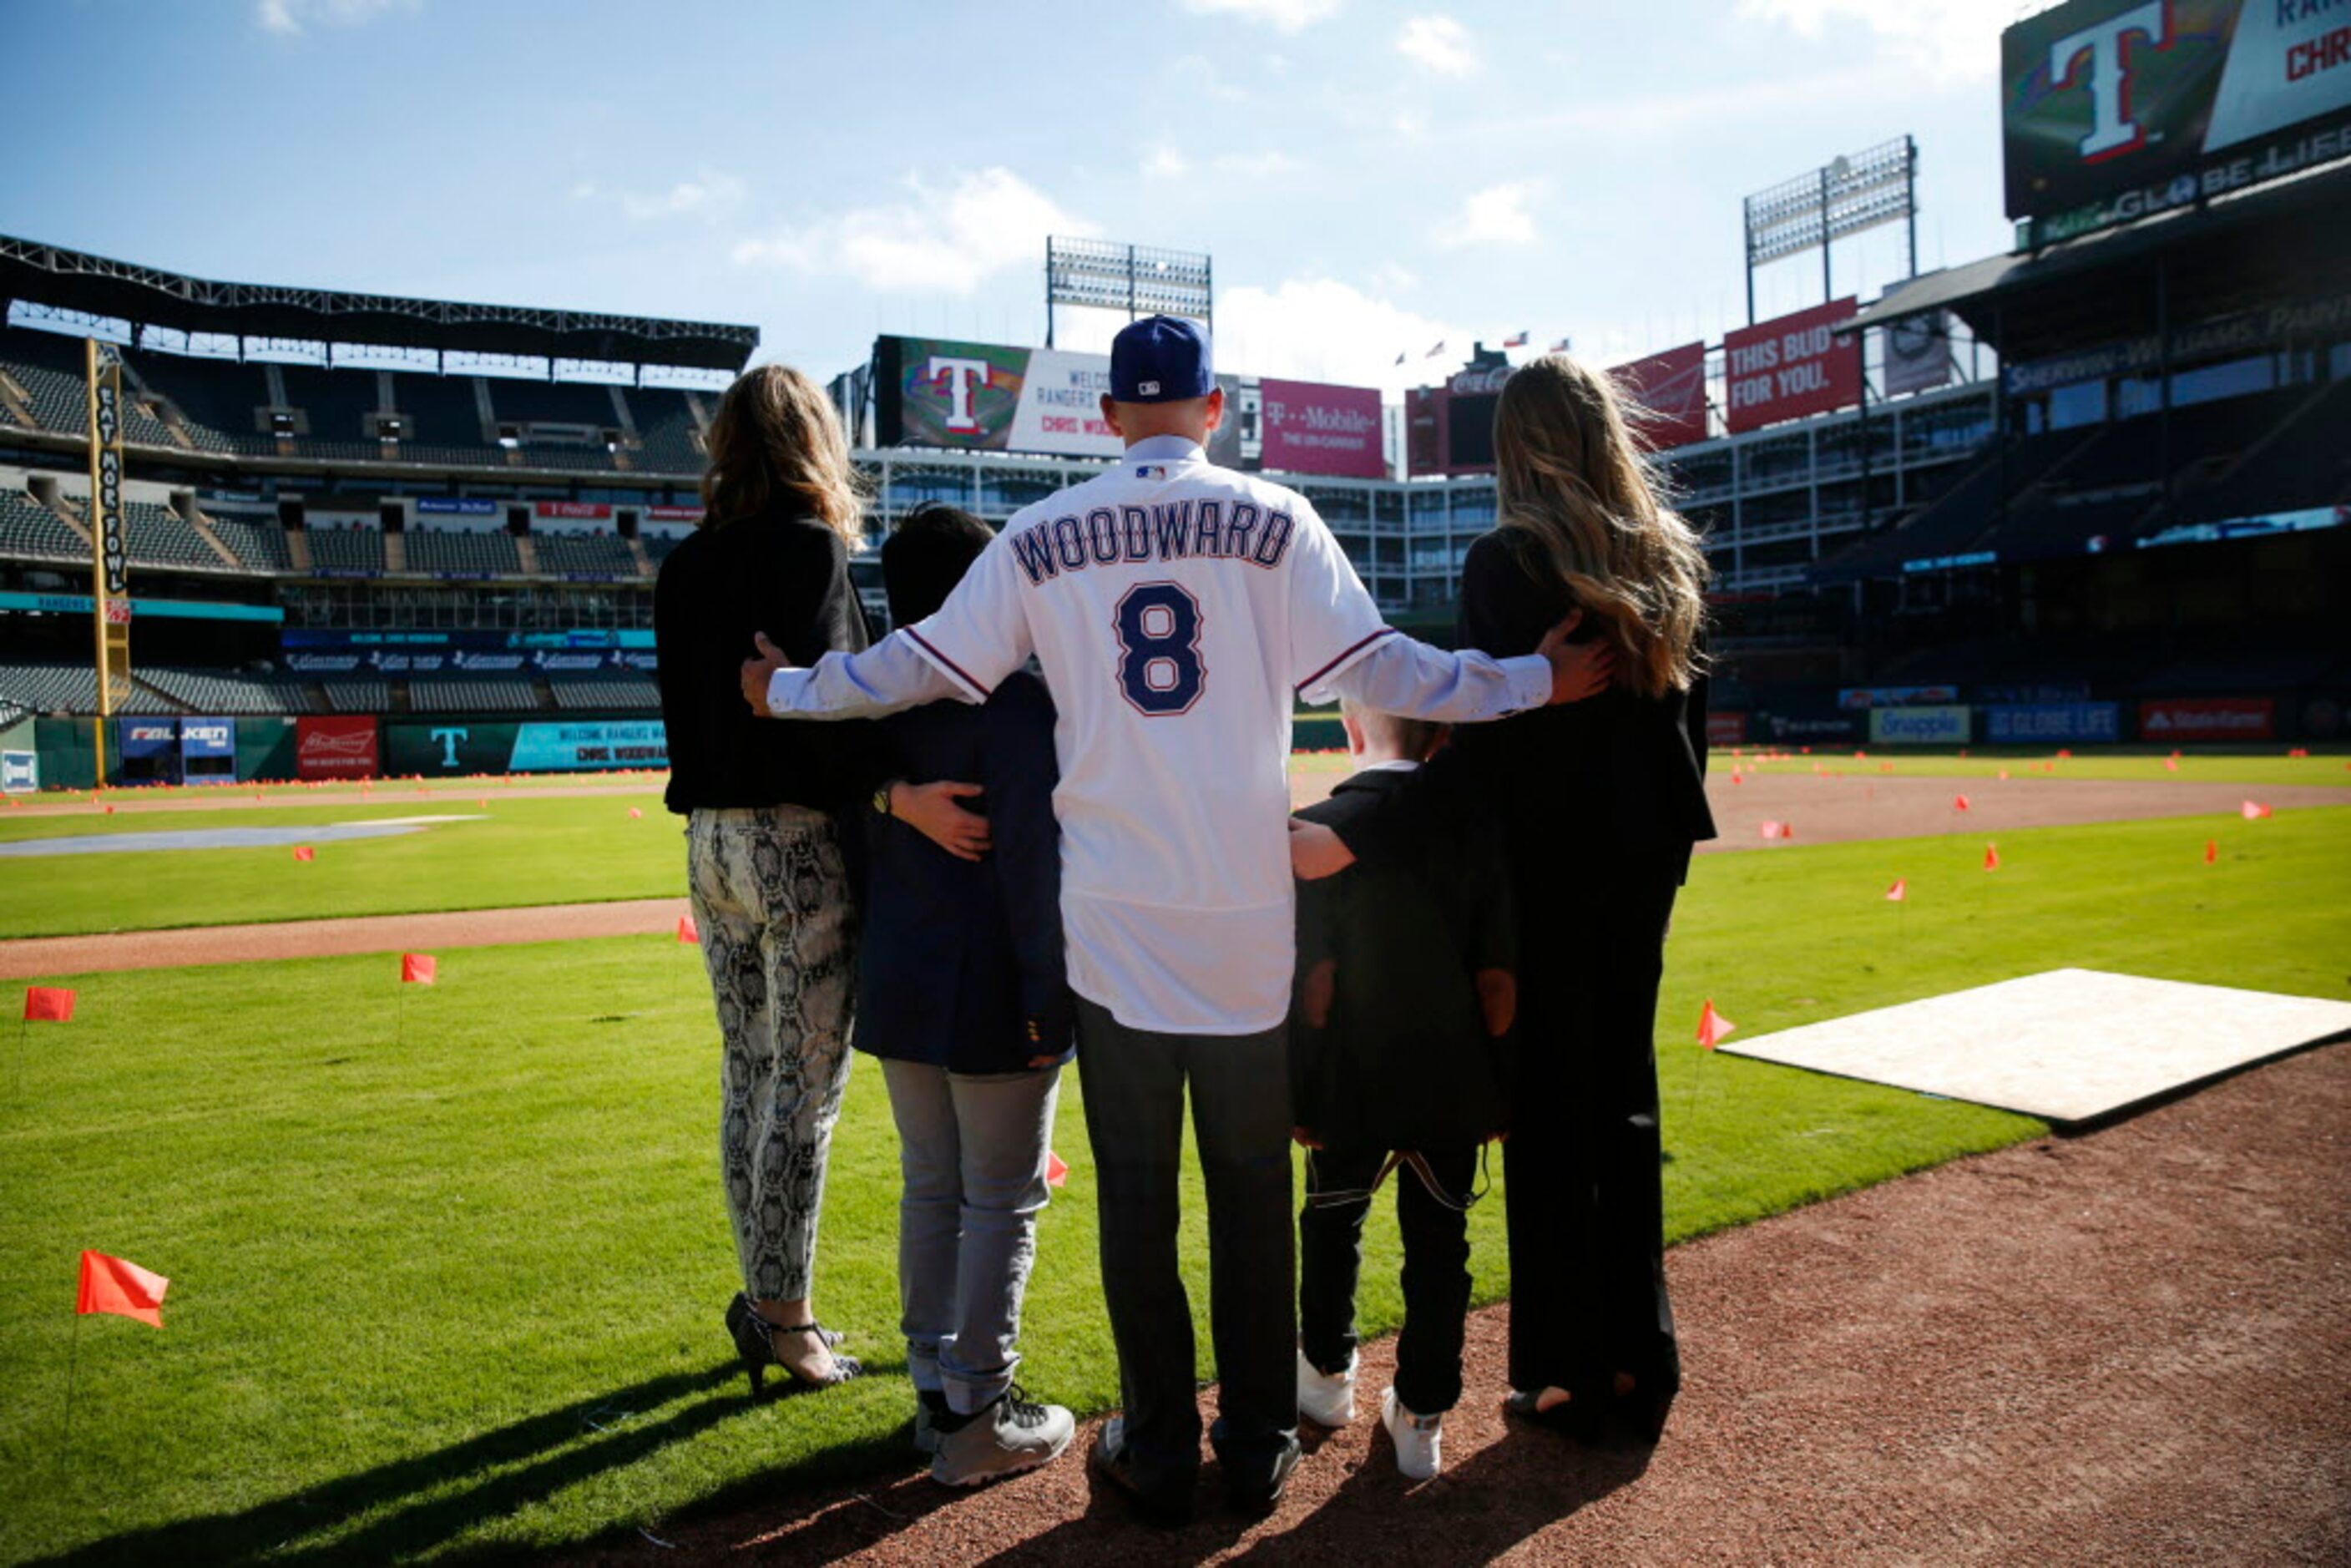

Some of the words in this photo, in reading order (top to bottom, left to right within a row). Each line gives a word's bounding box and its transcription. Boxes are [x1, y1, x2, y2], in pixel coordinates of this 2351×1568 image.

[2115, 159, 2252, 220] GLOBE
[1732, 338, 1778, 376] THIS
[2008, 338, 2256, 397] SHERWIN-WLLIAMS
[1037, 387, 1095, 409] RANGERS
[1069, 370, 1110, 390] WELCO
[1731, 374, 1773, 409] FOR
[1777, 361, 1830, 398] YOU.
[97, 387, 114, 443] EAT
[1042, 416, 1077, 433] CHRIS
[101, 451, 119, 508] MOR
[105, 517, 124, 591] FOWL
[1010, 498, 1295, 586] WOODWARD
[1111, 580, 1208, 717] 8
[560, 729, 600, 741] WELCOME
[1882, 711, 1959, 741] Snapple
[2012, 710, 2070, 735] GLOBE
[2076, 708, 2115, 734] LIFE
[576, 746, 609, 761] CHRIS
